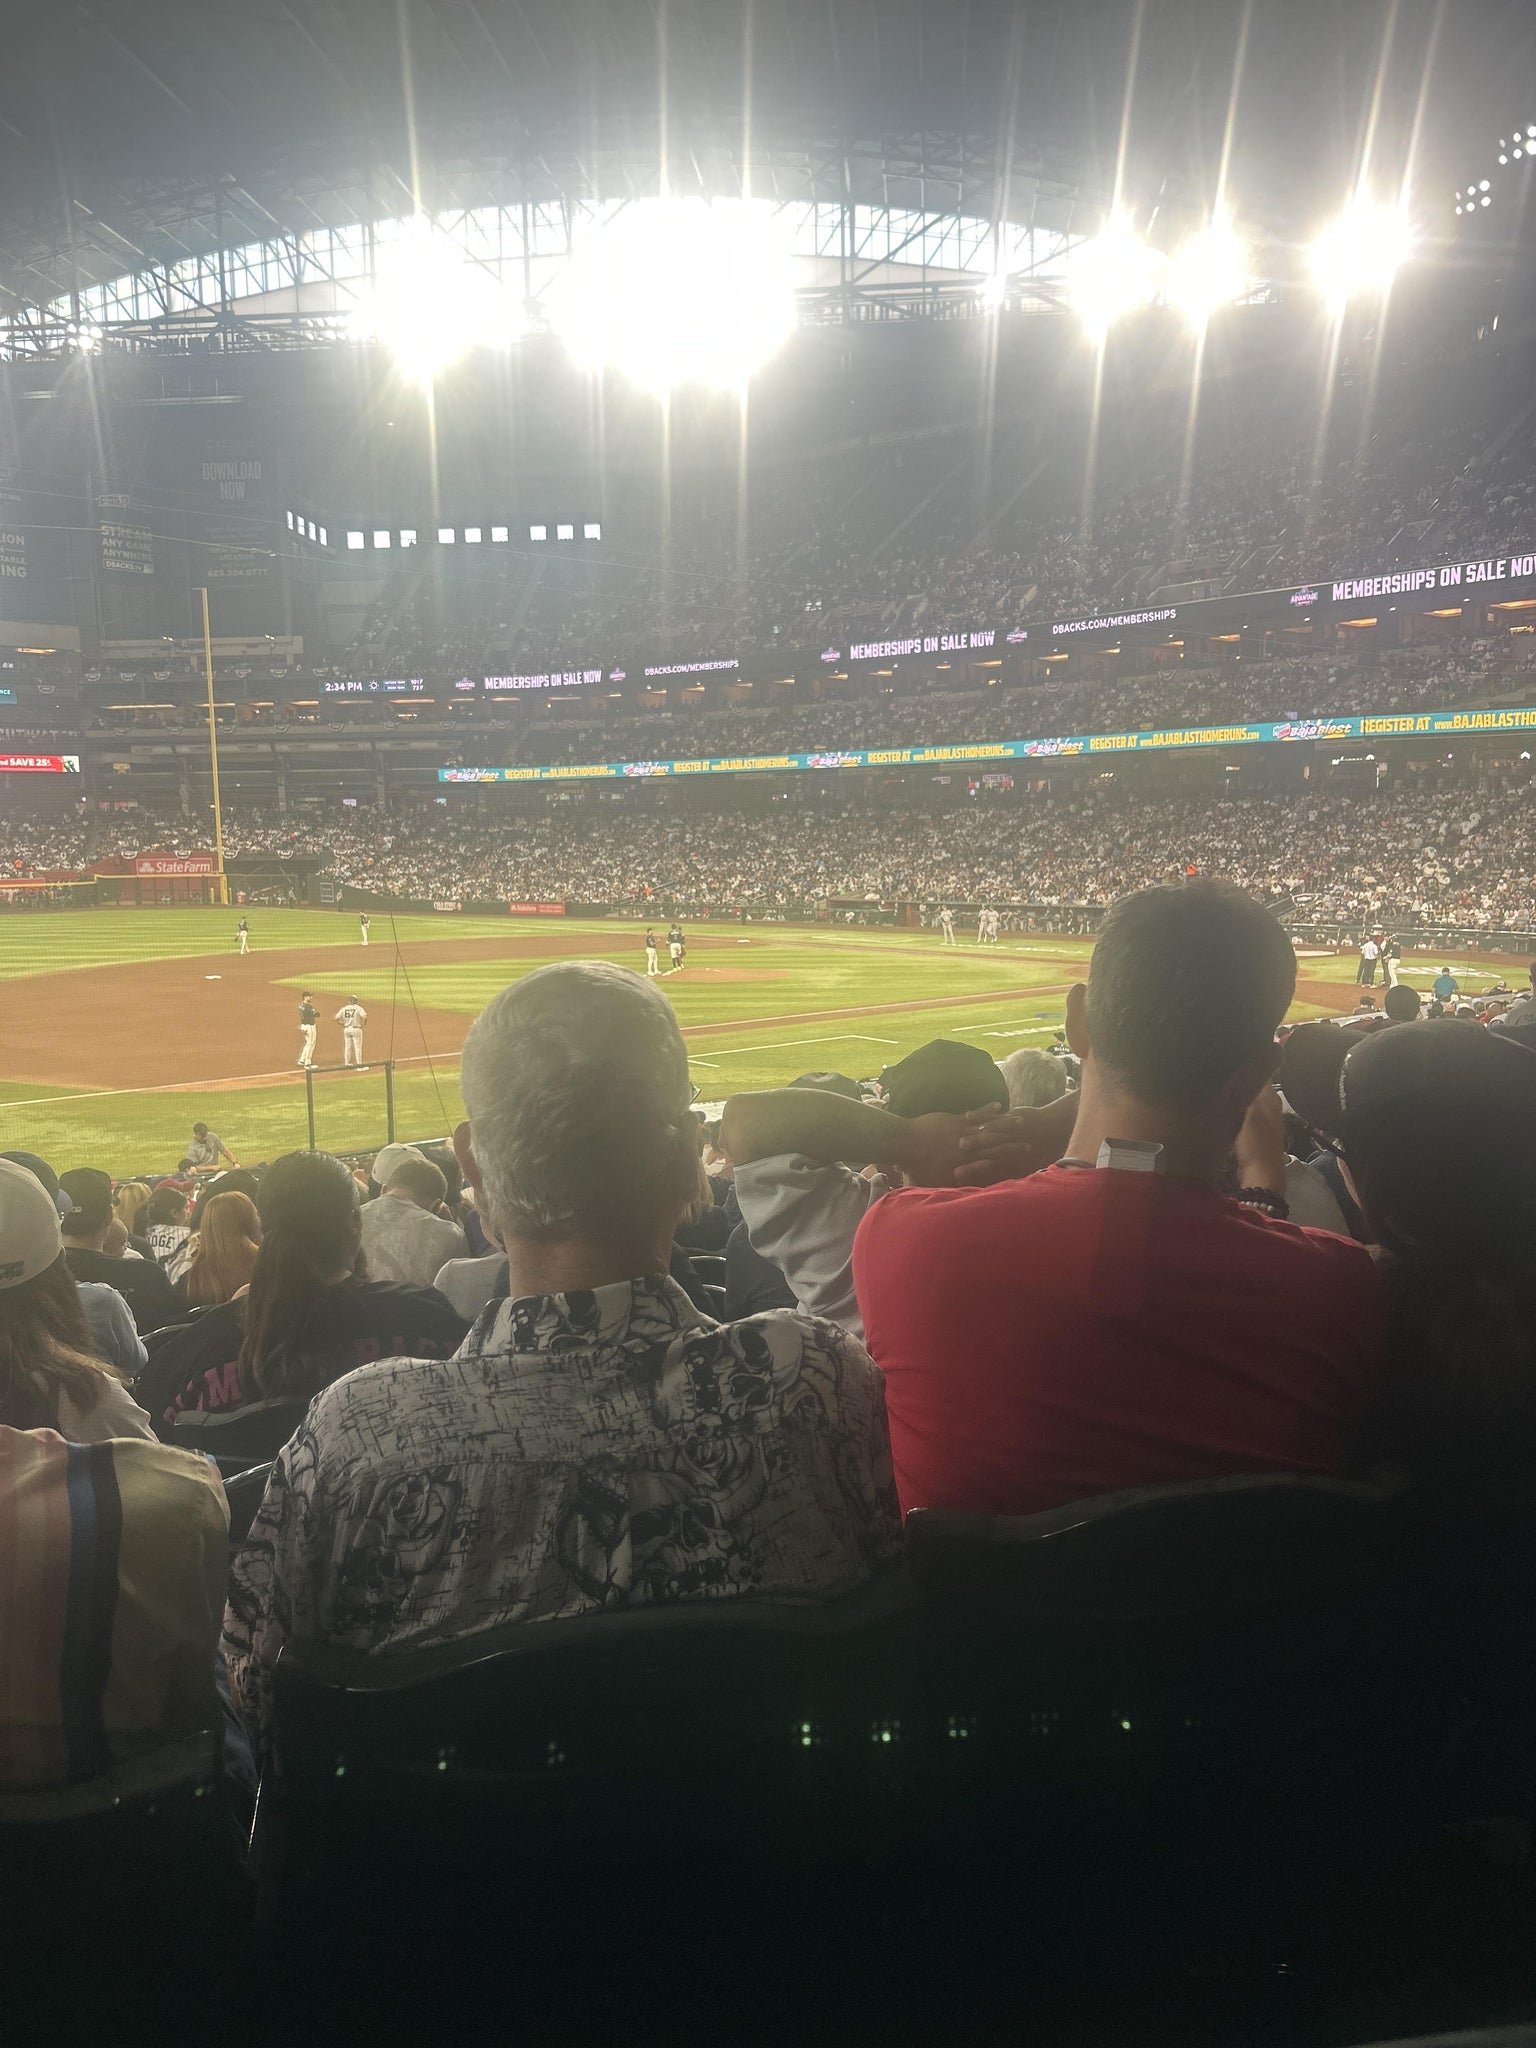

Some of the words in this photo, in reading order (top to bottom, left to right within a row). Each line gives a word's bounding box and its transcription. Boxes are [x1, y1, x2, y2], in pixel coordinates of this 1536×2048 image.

[202, 461, 262, 480] DOWNLOAD
[220, 481, 245, 500] NOW
[100, 526, 152, 540] STREAM
[102, 538, 121, 547] ANY
[126, 541, 152, 551] GAME
[103, 549, 152, 561] ANYWHERE
[1332, 570, 1436, 601] MEMBERSHIPS
[1440, 566, 1461, 586] ON
[1466, 560, 1507, 584] SALE
[1510, 555, 1536, 578] NO
[1052, 609, 1177, 635] DBACKS.COM/MEMBERSHIPS
[850, 640, 922, 660] MEMBERSHIPS
[924, 637, 938, 652] ON
[941, 634, 967, 651] SALE
[970, 630, 996, 648] NOW
[644, 660, 740, 676] DBACKS.COM/MEMBERSHIPS
[325, 682, 345, 692] 2:34
[347, 681, 363, 691] PM
[484, 675, 550, 690] MEMBERSHIPS
[550, 674, 562, 687] ON
[563, 672, 582, 686] SALE
[583, 670, 602, 684] NOW
[1360, 717, 1414, 733] REGISTER
[1416, 716, 1431, 731] AT
[1090, 737, 1126, 750] REGISTER
[1127, 735, 1138, 748] AT
[9, 758, 35, 766] SAVE
[867, 751, 901, 764] REGISTER
[902, 751, 911, 762] AT
[674, 761, 701, 773] REGISTER
[702, 761, 710, 772] AT
[344, 1009, 356, 1018] 67
